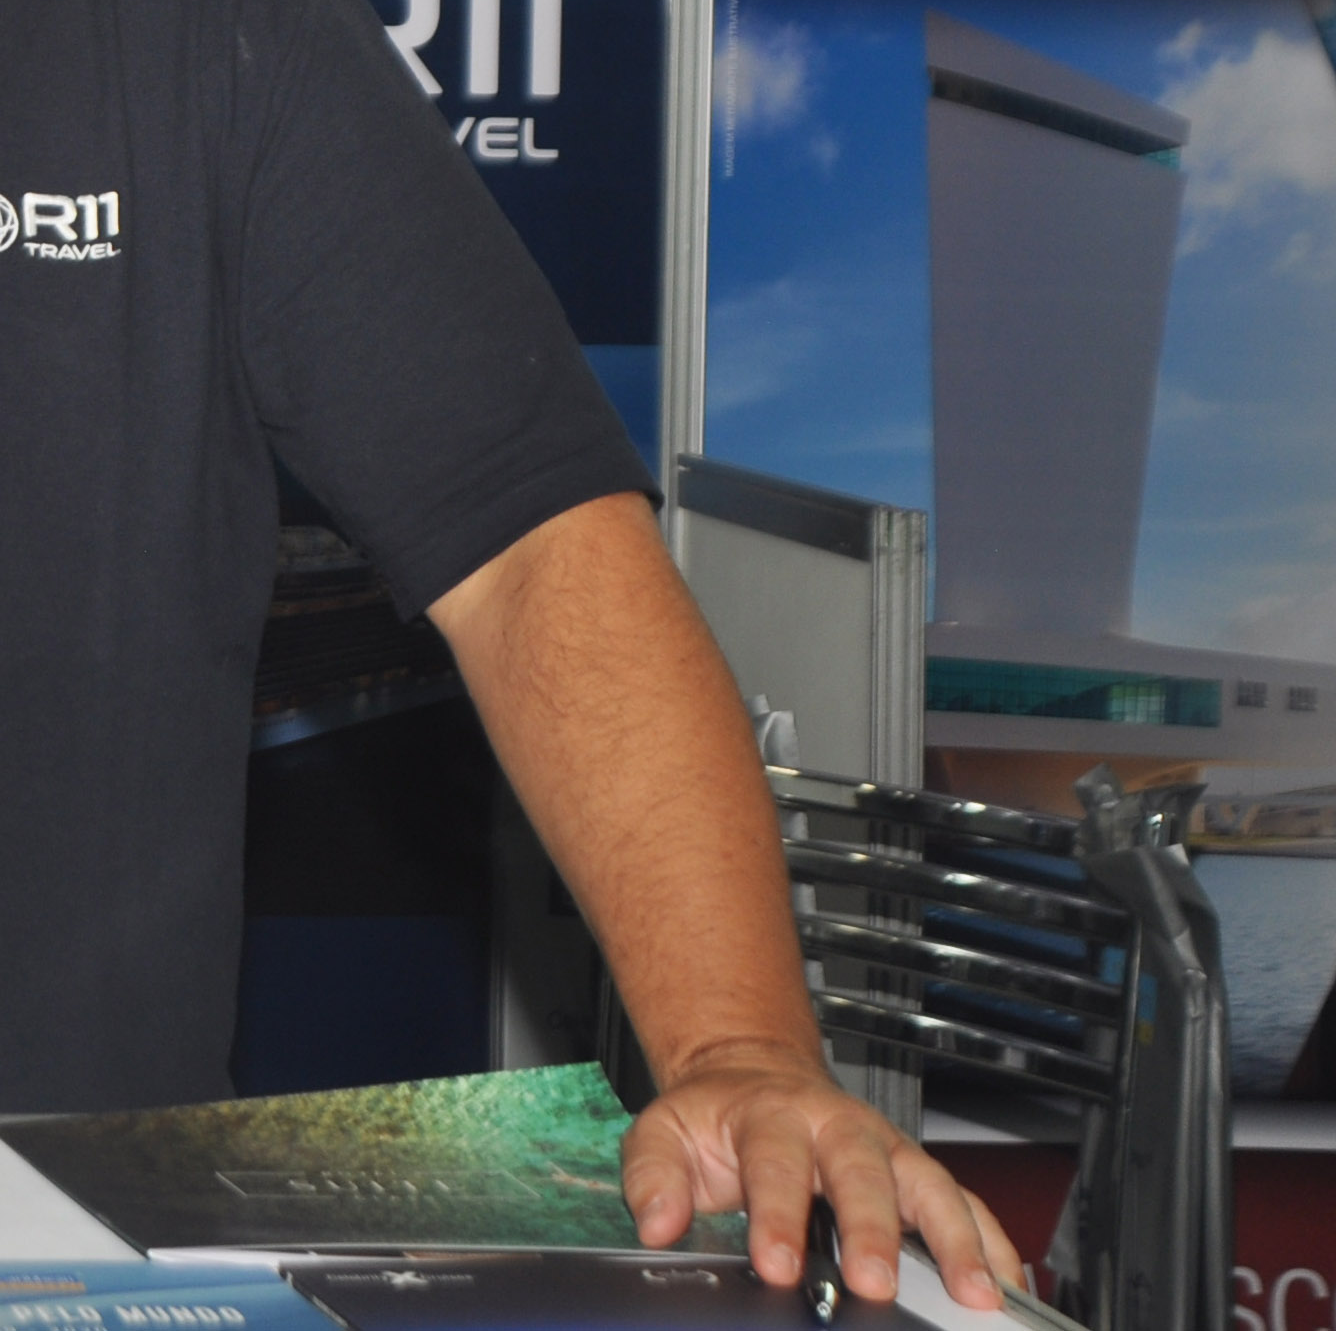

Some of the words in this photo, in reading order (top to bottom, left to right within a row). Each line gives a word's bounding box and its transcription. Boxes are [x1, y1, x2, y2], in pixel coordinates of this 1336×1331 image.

[23, 192, 120, 241] R11
[24, 242, 122, 261] TRAVEL
[10, 1303, 103, 1324] PELO
[115, 1305, 247, 1325] MUNDO
